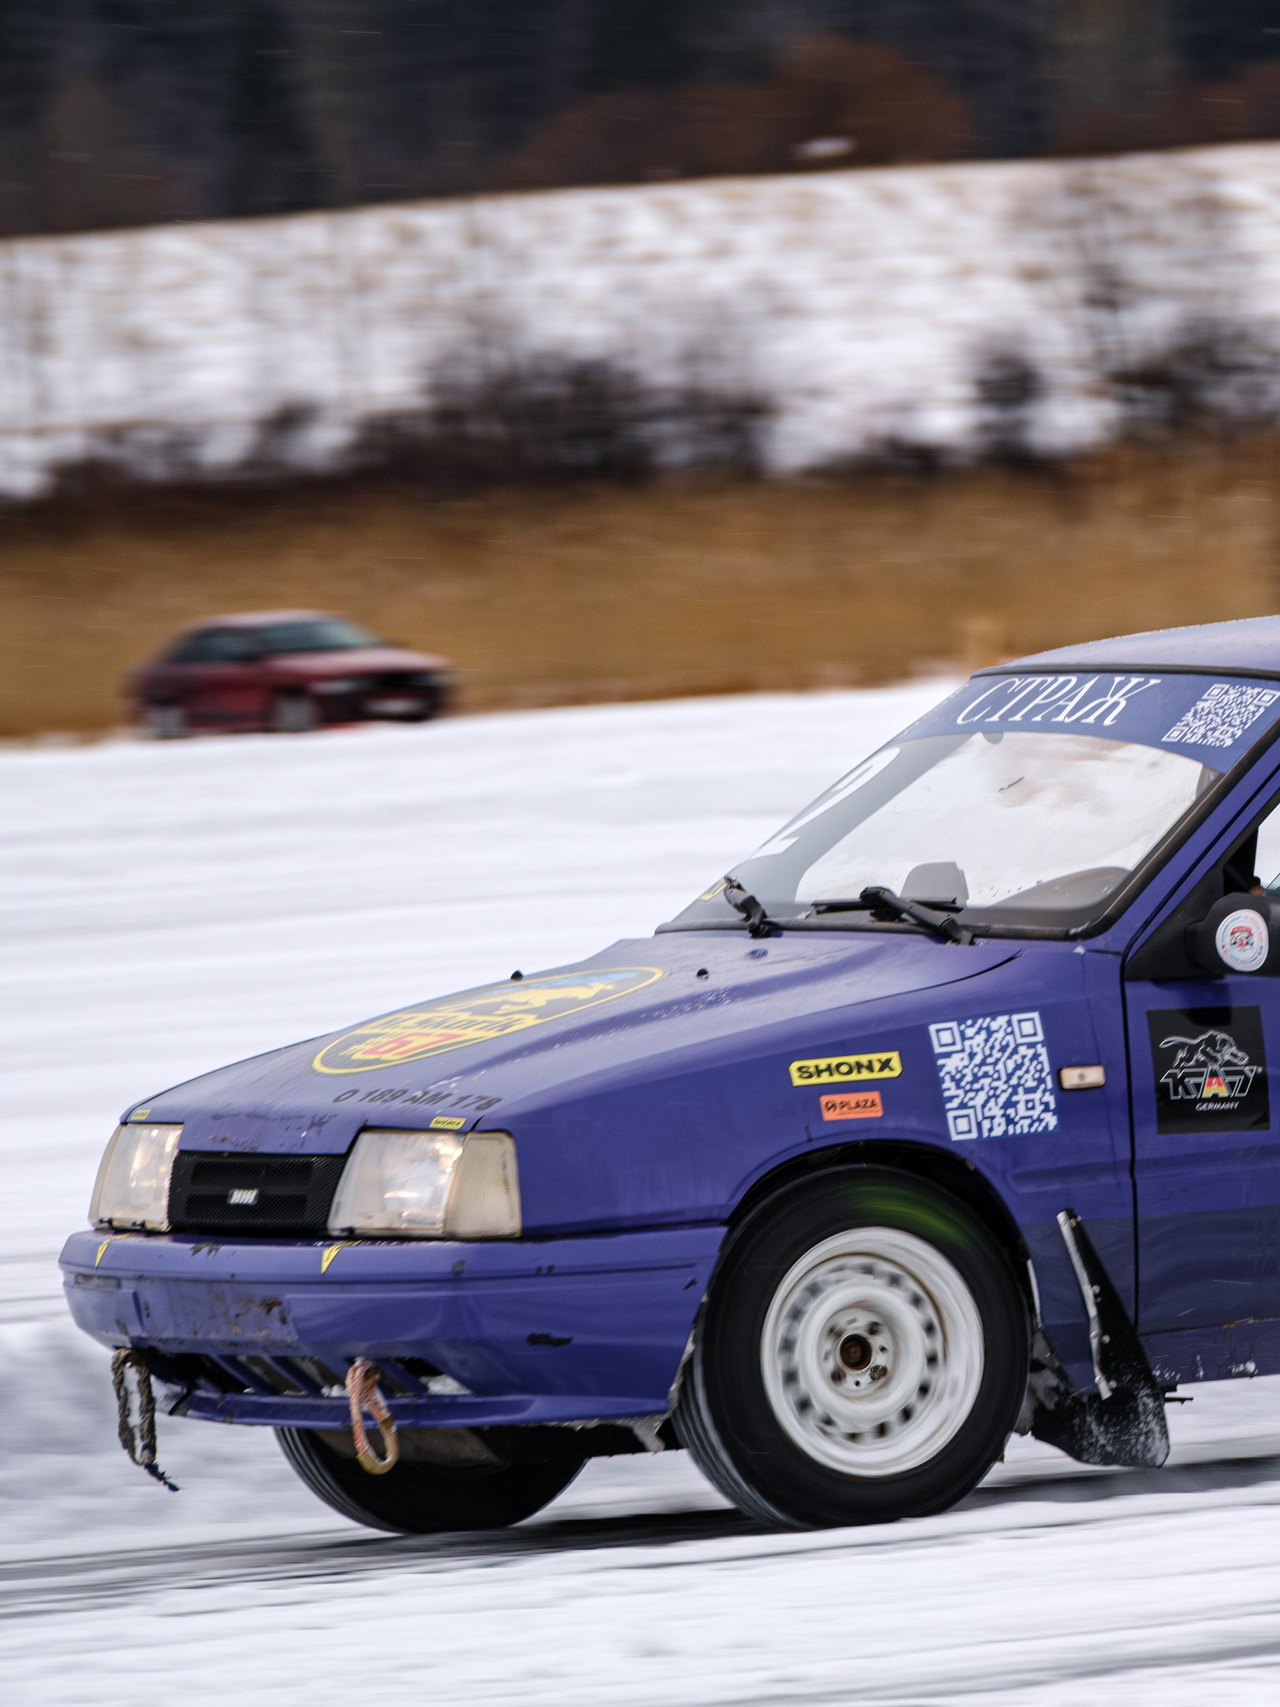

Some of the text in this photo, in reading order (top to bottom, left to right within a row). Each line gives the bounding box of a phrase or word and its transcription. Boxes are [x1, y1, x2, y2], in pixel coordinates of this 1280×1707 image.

[956, 675, 1162, 727] СТРАЖ
[359, 1031, 469, 1057] 67
[797, 1057, 896, 1079] SHONX
[356, 1088, 409, 1104] 189
[446, 1093, 504, 1112] 178
[1195, 1101, 1240, 1112] GERMANY
